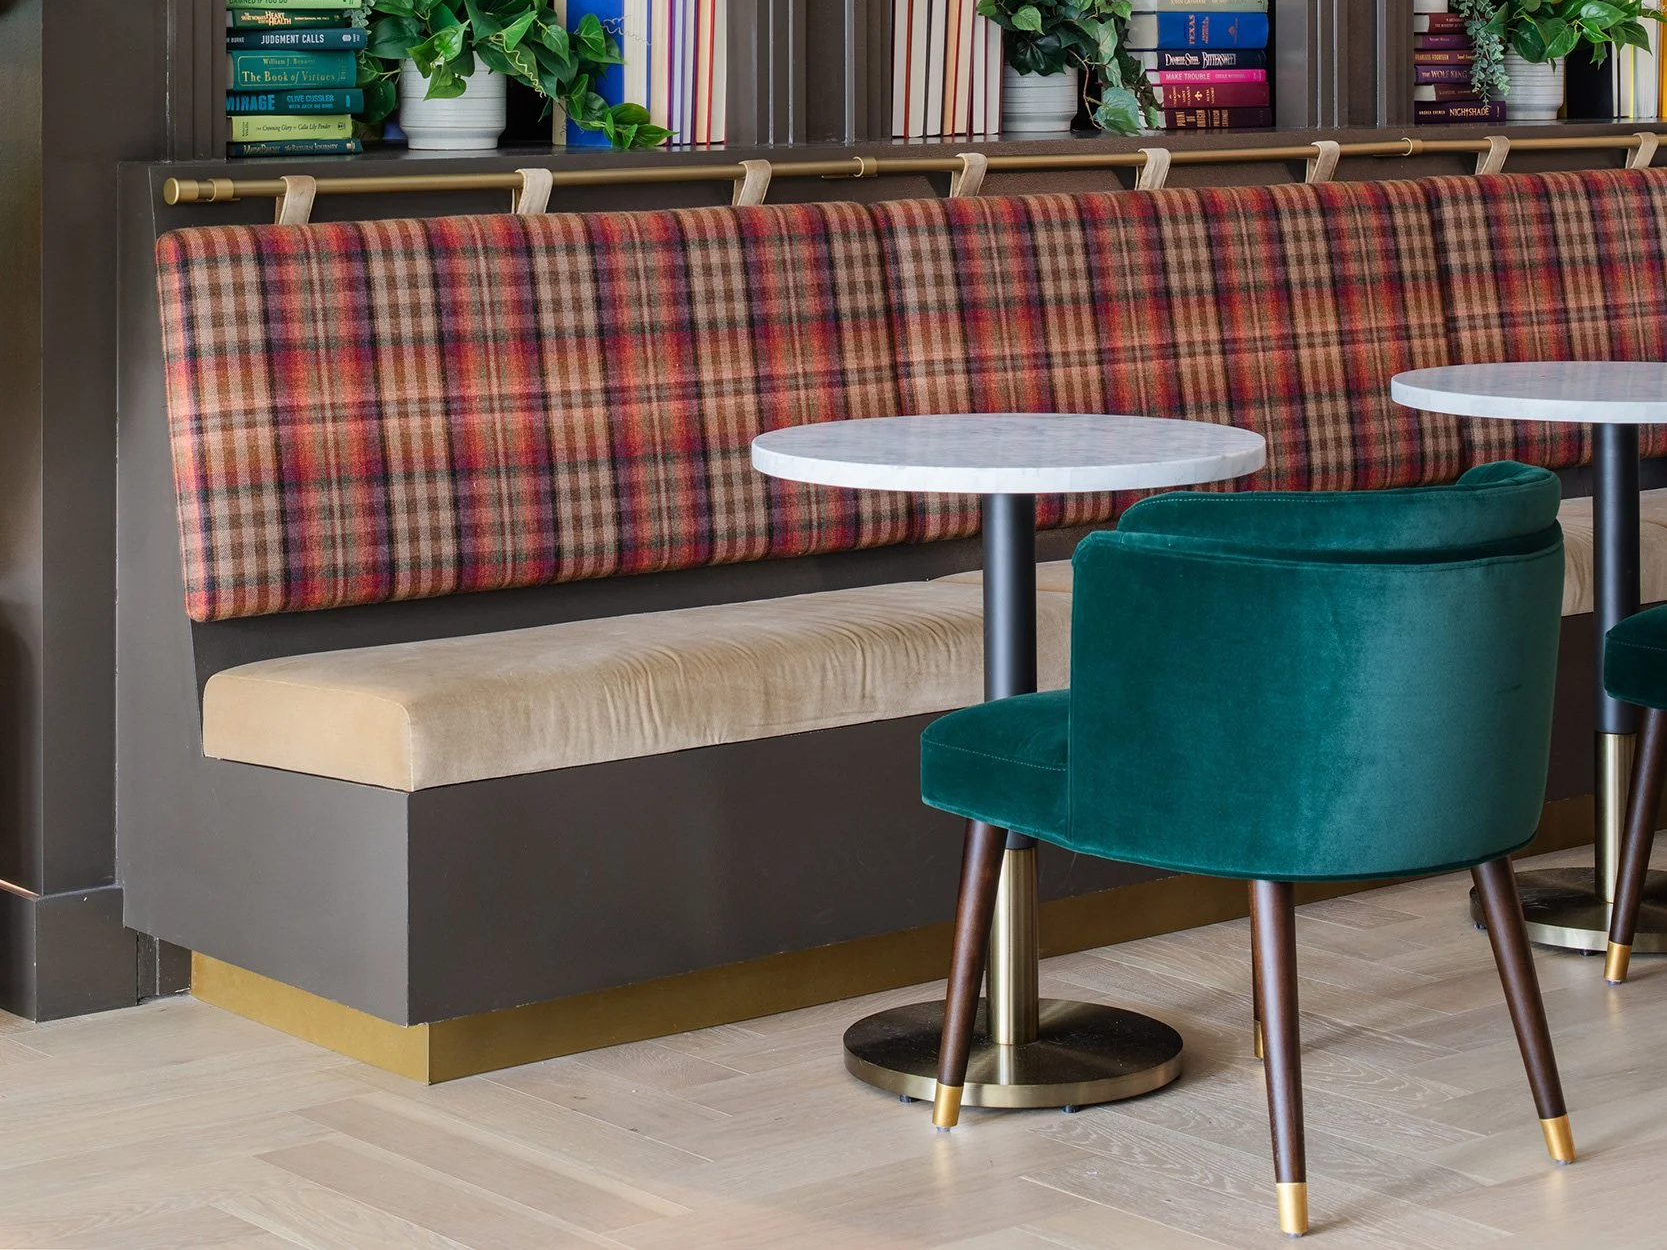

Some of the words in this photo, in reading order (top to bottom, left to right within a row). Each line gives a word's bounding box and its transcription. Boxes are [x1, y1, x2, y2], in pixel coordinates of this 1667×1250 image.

[268, 17, 291, 26] HEALTH
[261, 34, 300, 44] JUDGMENT
[302, 34, 324, 44] CALLS
[242, 71, 261, 82] The
[264, 71, 288, 82] Book
[290, 71, 300, 84] of
[301, 71, 335, 82] Virtues
[1431, 71, 1449, 79] WOLF
[1451, 71, 1467, 79] KING
[226, 94, 275, 111] MIRAGE
[287, 95, 304, 103] CLIVE
[305, 95, 334, 103] CUSSLER
[1449, 107, 1489, 116] NIGHTSHADE
